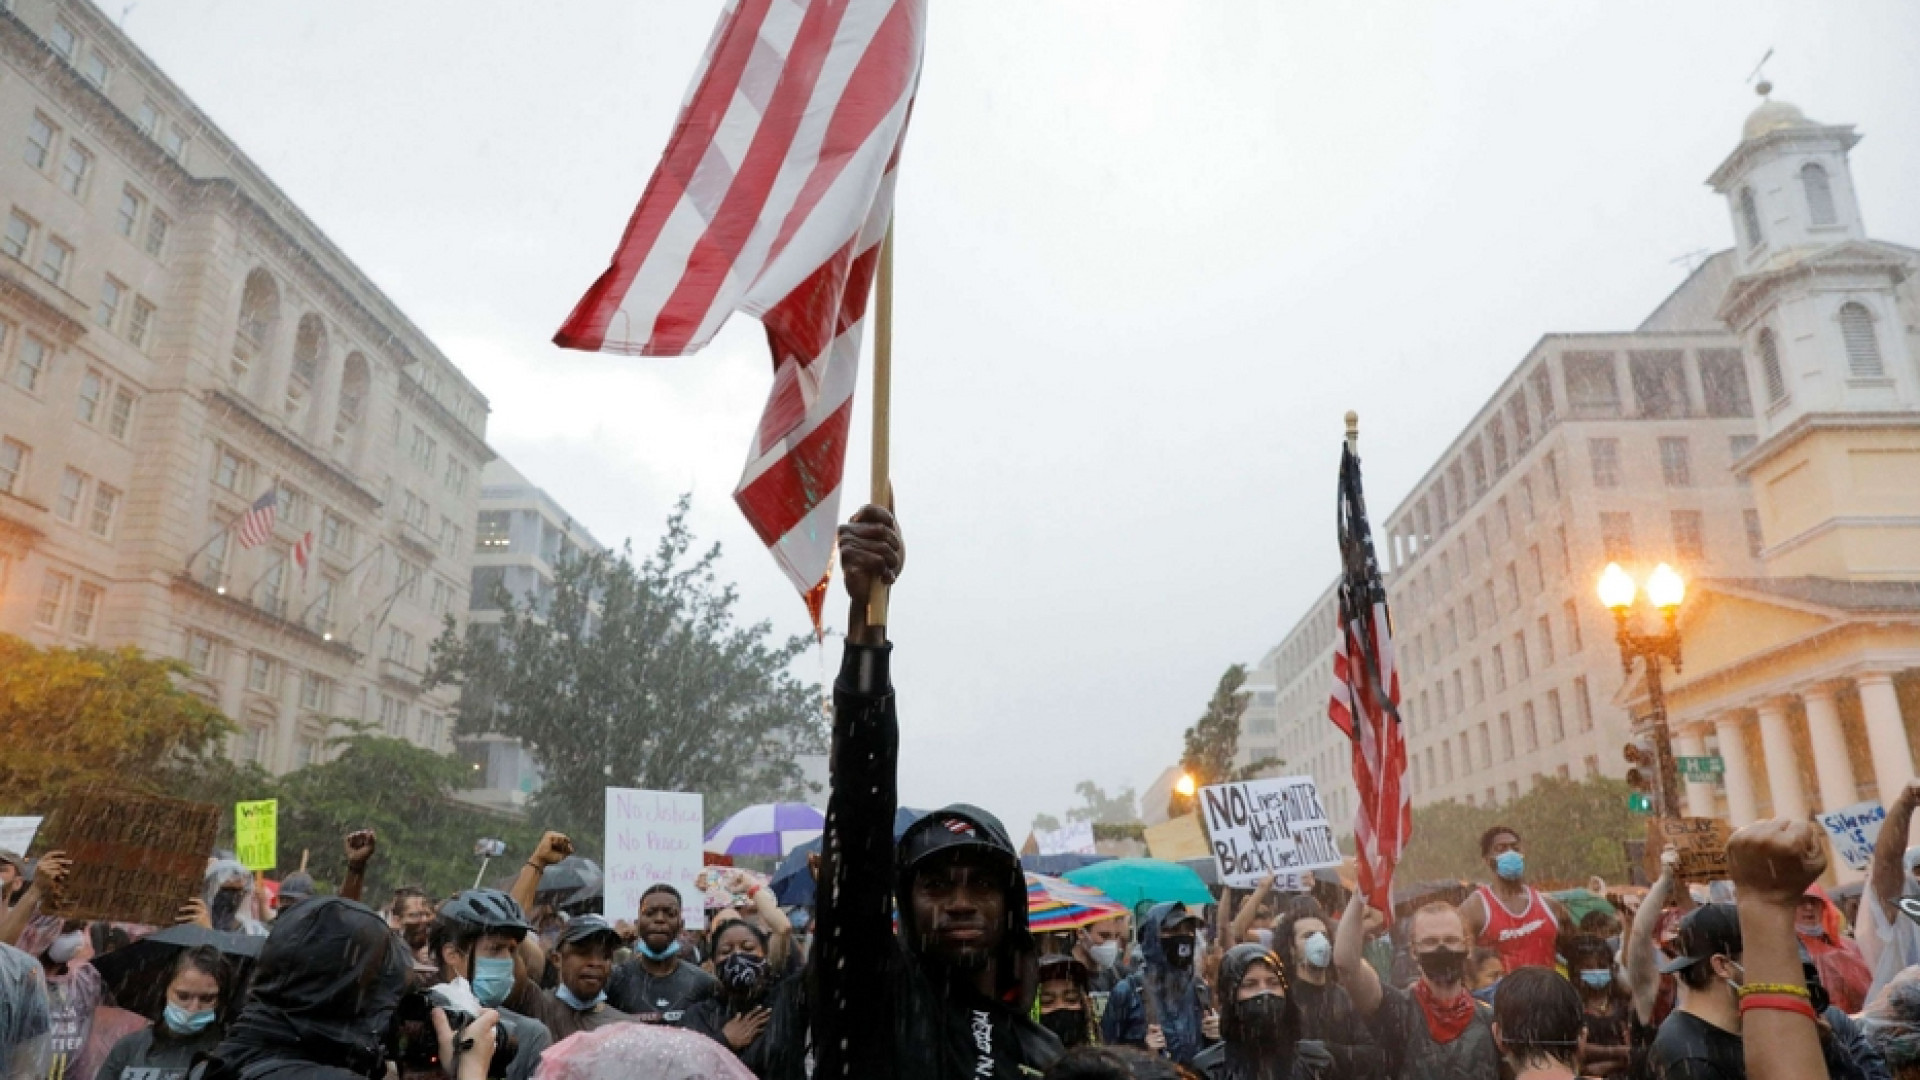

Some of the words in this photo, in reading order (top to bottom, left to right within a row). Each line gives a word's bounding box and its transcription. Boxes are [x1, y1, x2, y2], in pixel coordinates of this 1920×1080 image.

[617, 793, 642, 820] No
[1204, 785, 1247, 831] NO
[617, 828, 641, 852] No
[1214, 837, 1269, 876] Black
